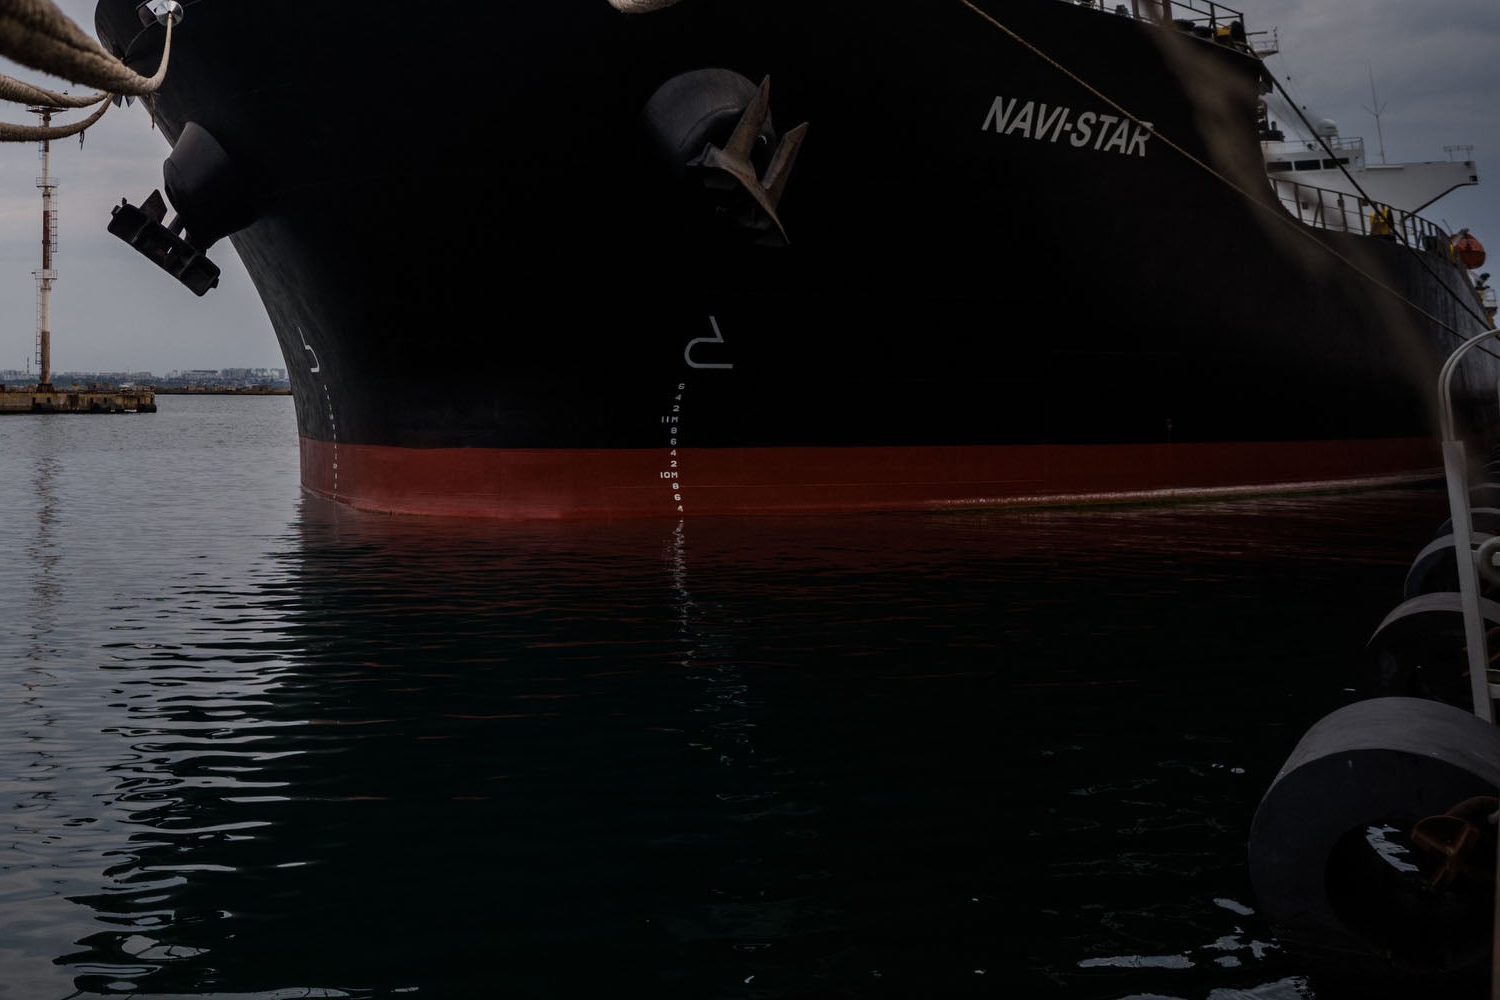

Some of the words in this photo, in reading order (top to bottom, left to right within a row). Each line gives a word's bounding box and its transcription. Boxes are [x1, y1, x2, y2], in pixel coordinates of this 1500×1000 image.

[981, 95, 1154, 157] NAVI-STAR
[672, 404, 680, 412] 2
[670, 427, 677, 435] 8
[670, 460, 677, 468] 2
[660, 471, 679, 479] 10M
